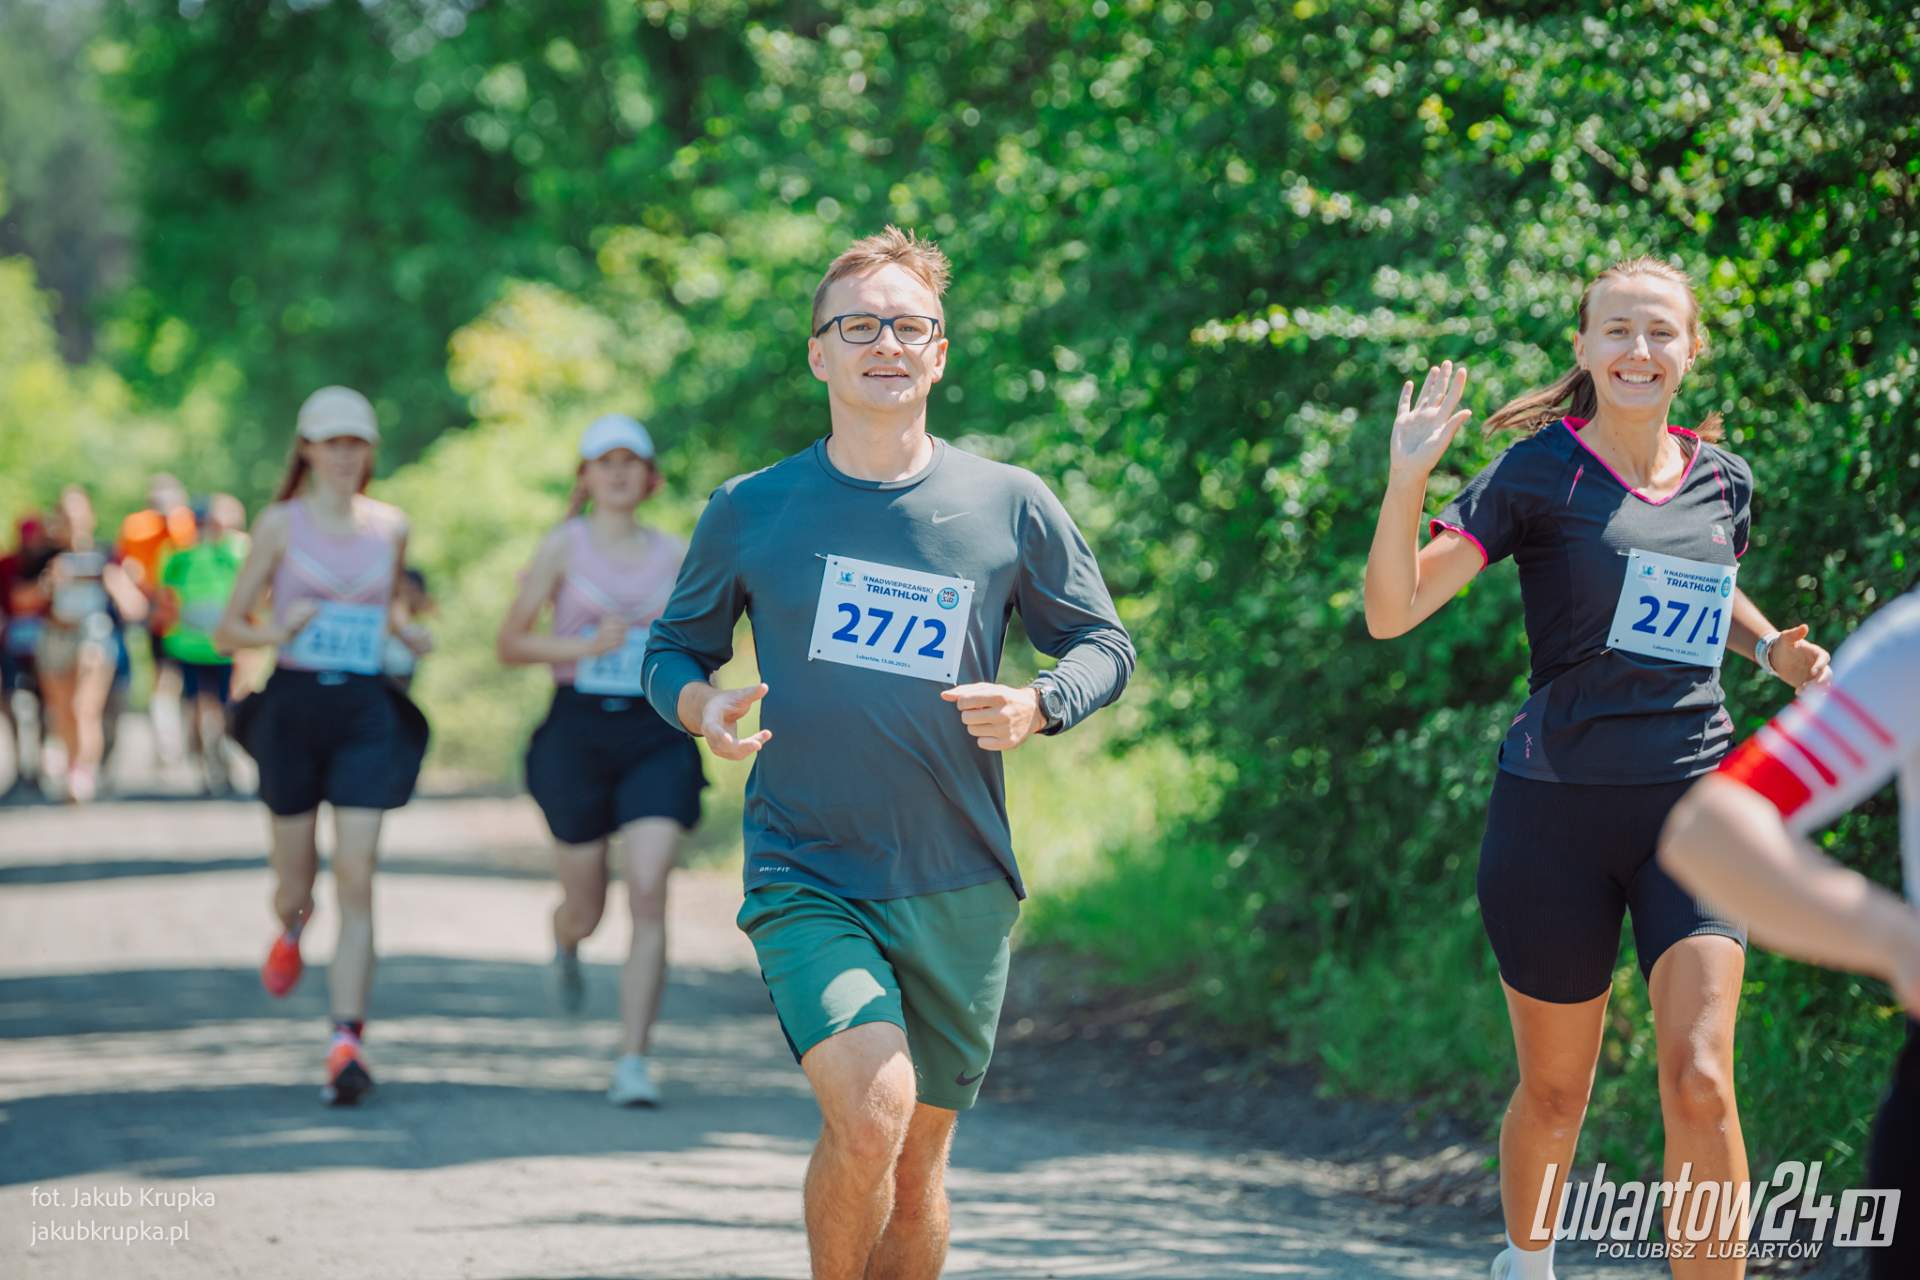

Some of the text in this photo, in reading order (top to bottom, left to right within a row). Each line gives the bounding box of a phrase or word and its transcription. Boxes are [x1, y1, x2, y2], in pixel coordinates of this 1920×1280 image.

[866, 583, 928, 603] TRIATHLON
[1666, 577, 1717, 593] TRIATHLON
[832, 602, 947, 659] 27/2
[1631, 595, 1722, 645] 27/1
